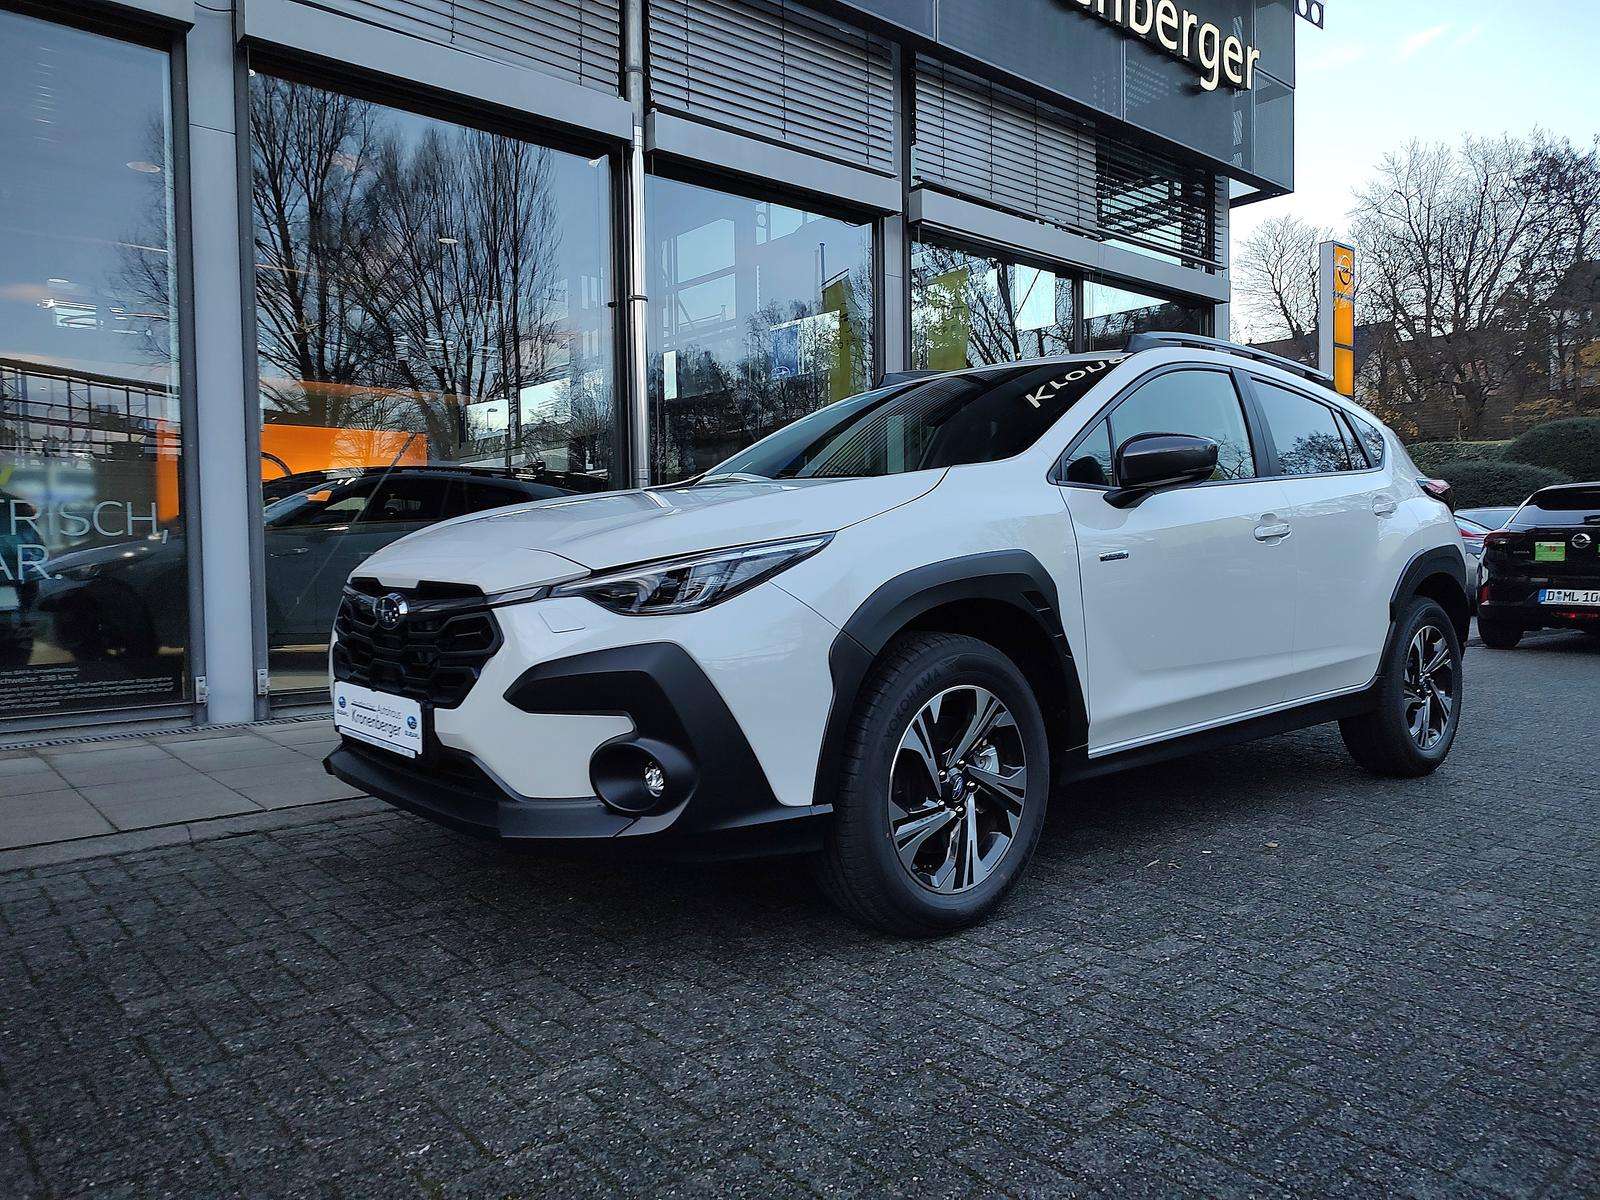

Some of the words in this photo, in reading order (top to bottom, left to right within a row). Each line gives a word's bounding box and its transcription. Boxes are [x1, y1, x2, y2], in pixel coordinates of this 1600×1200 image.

[1076, 0, 1260, 91] berger
[0, 498, 169, 544] RISCH,
[1546, 590, 1555, 601] D
[1562, 591, 1579, 602] ML
[1582, 591, 1600, 603] 10
[351, 708, 402, 738] Kronenberger
